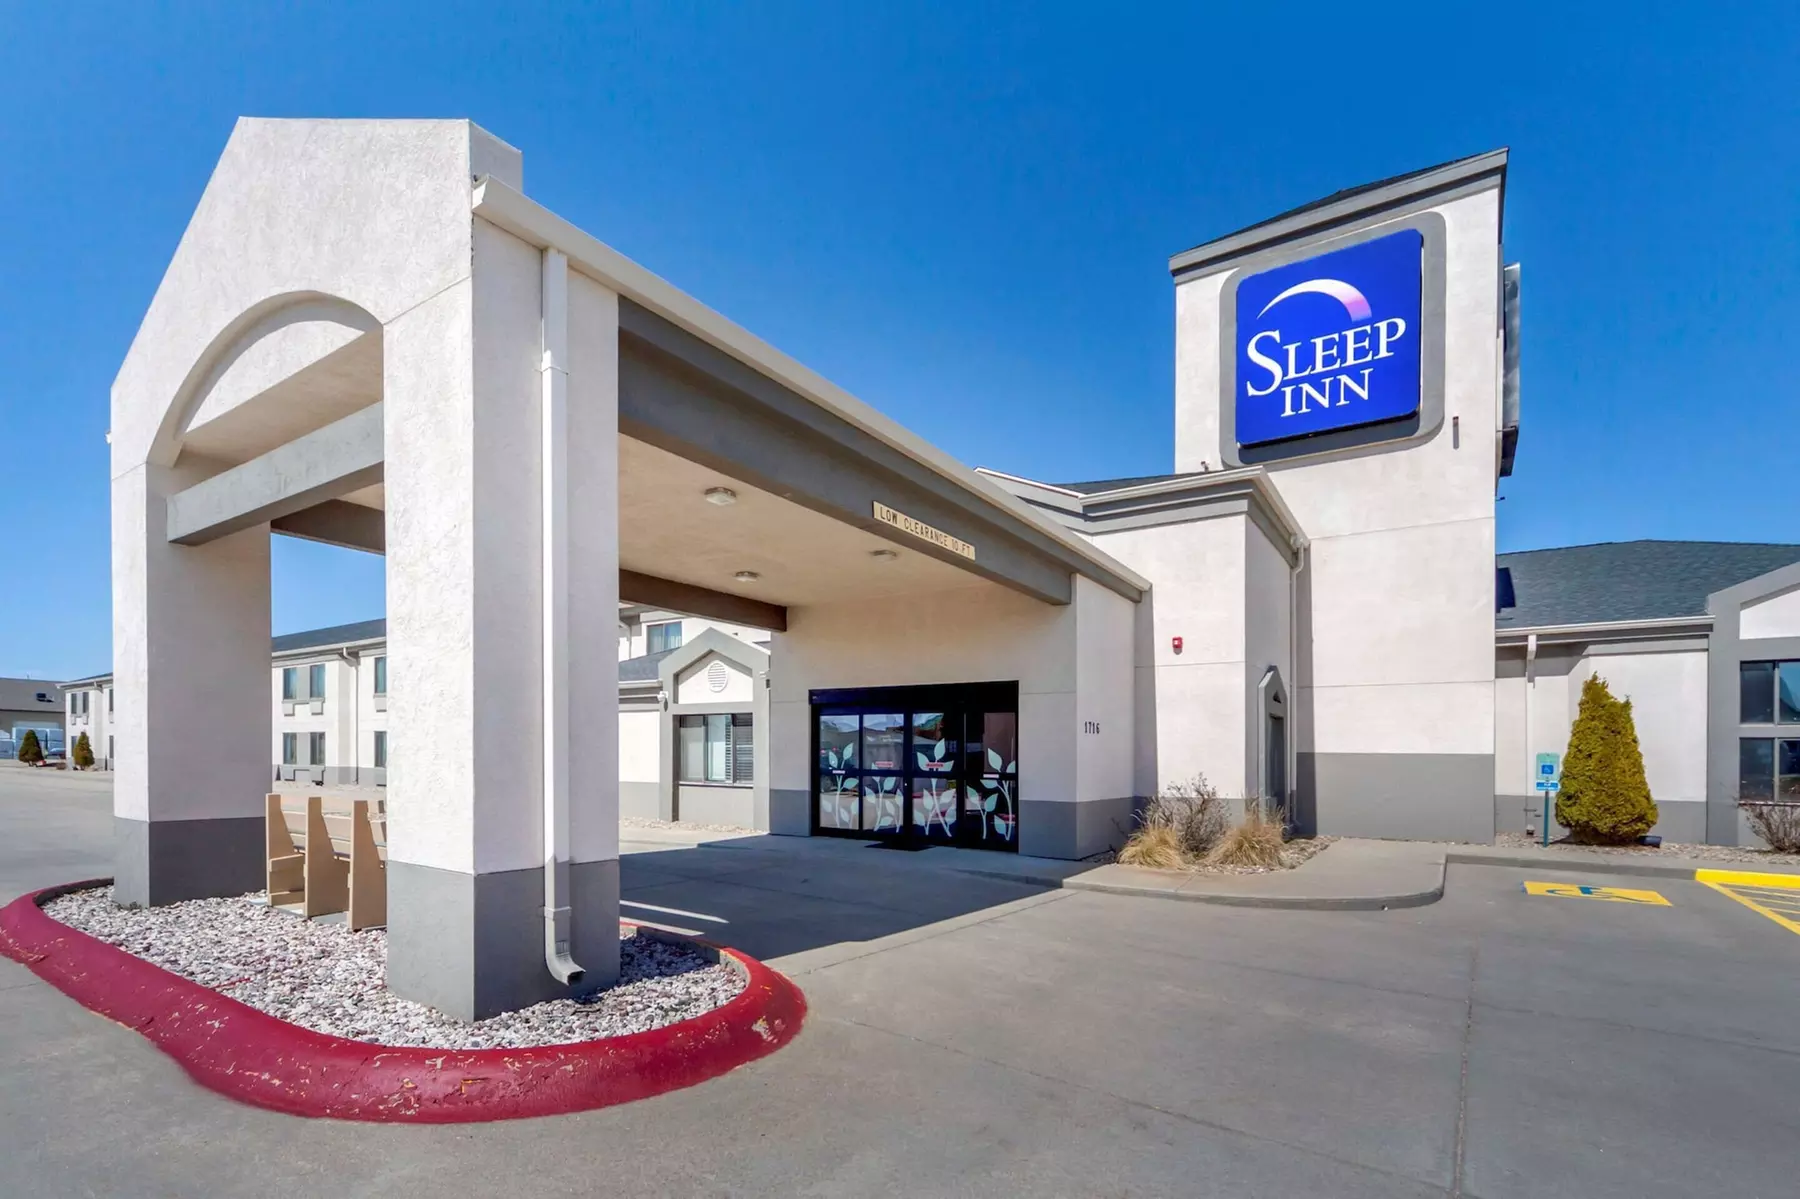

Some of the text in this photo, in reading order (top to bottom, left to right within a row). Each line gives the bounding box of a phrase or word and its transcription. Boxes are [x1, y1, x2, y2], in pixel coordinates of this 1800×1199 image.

[1246, 317, 1406, 396] SLEEP
[1280, 368, 1374, 417] INN
[880, 506, 898, 525] LOW
[904, 518, 948, 547] CLEARANCE
[962, 543, 971, 557] FT
[1084, 721, 1100, 734] 1716
